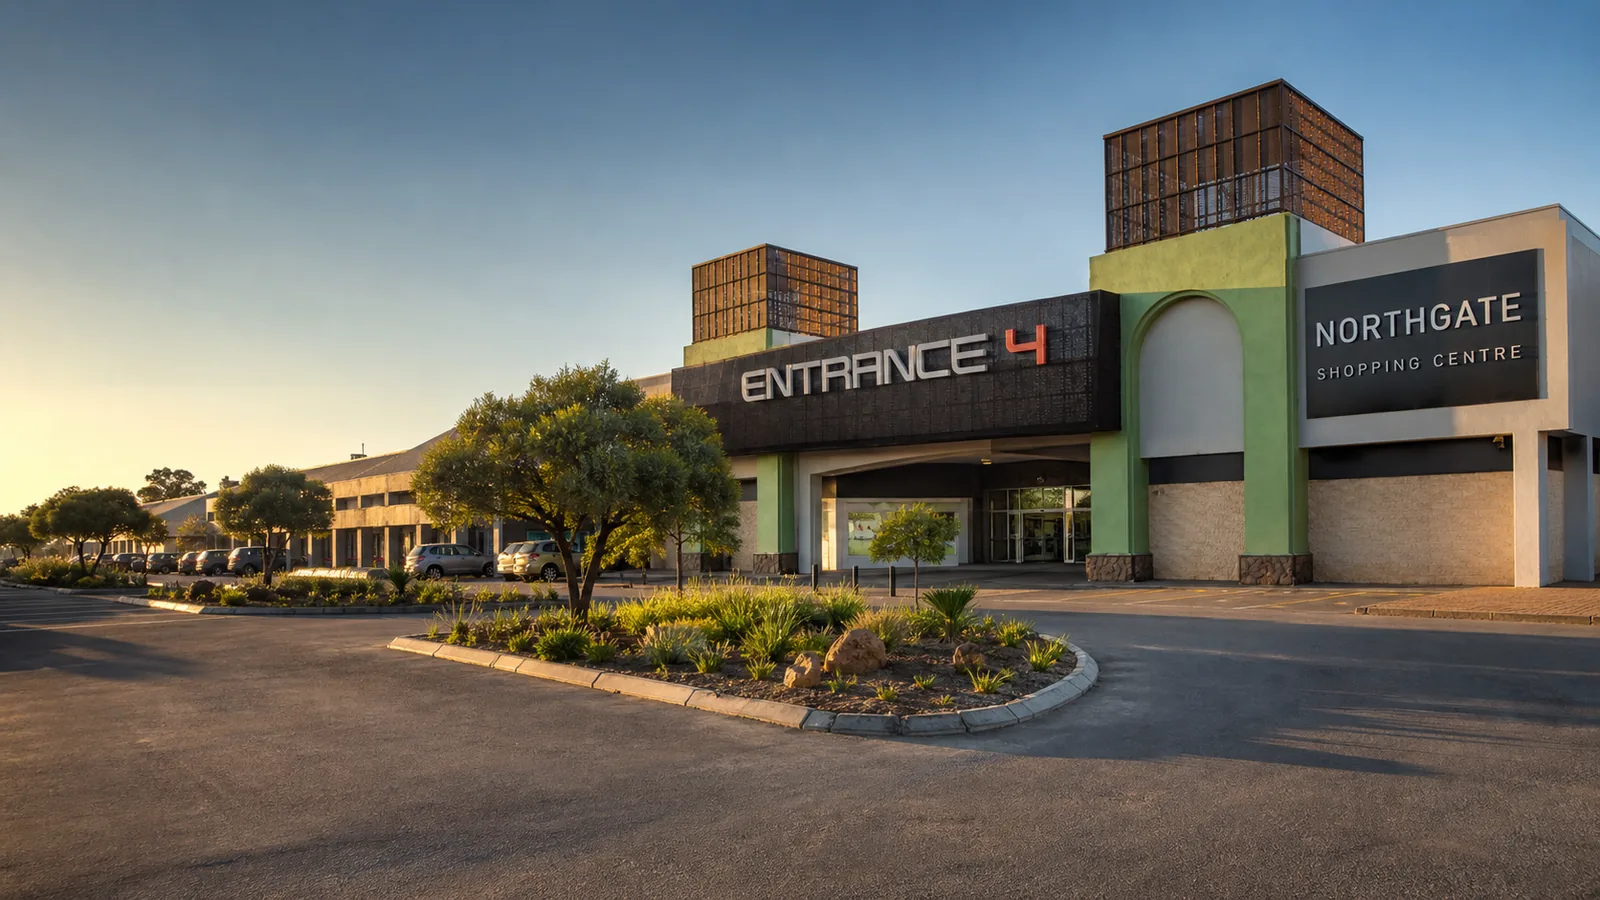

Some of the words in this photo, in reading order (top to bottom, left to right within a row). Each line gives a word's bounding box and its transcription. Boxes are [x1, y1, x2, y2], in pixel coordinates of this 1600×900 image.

[1316, 292, 1522, 347] NORTHGATE
[741, 333, 989, 403] ENTRANCE
[1005, 324, 1047, 365] 4
[1317, 357, 1420, 381] SHOPPING
[1433, 345, 1522, 368] CENTRE
